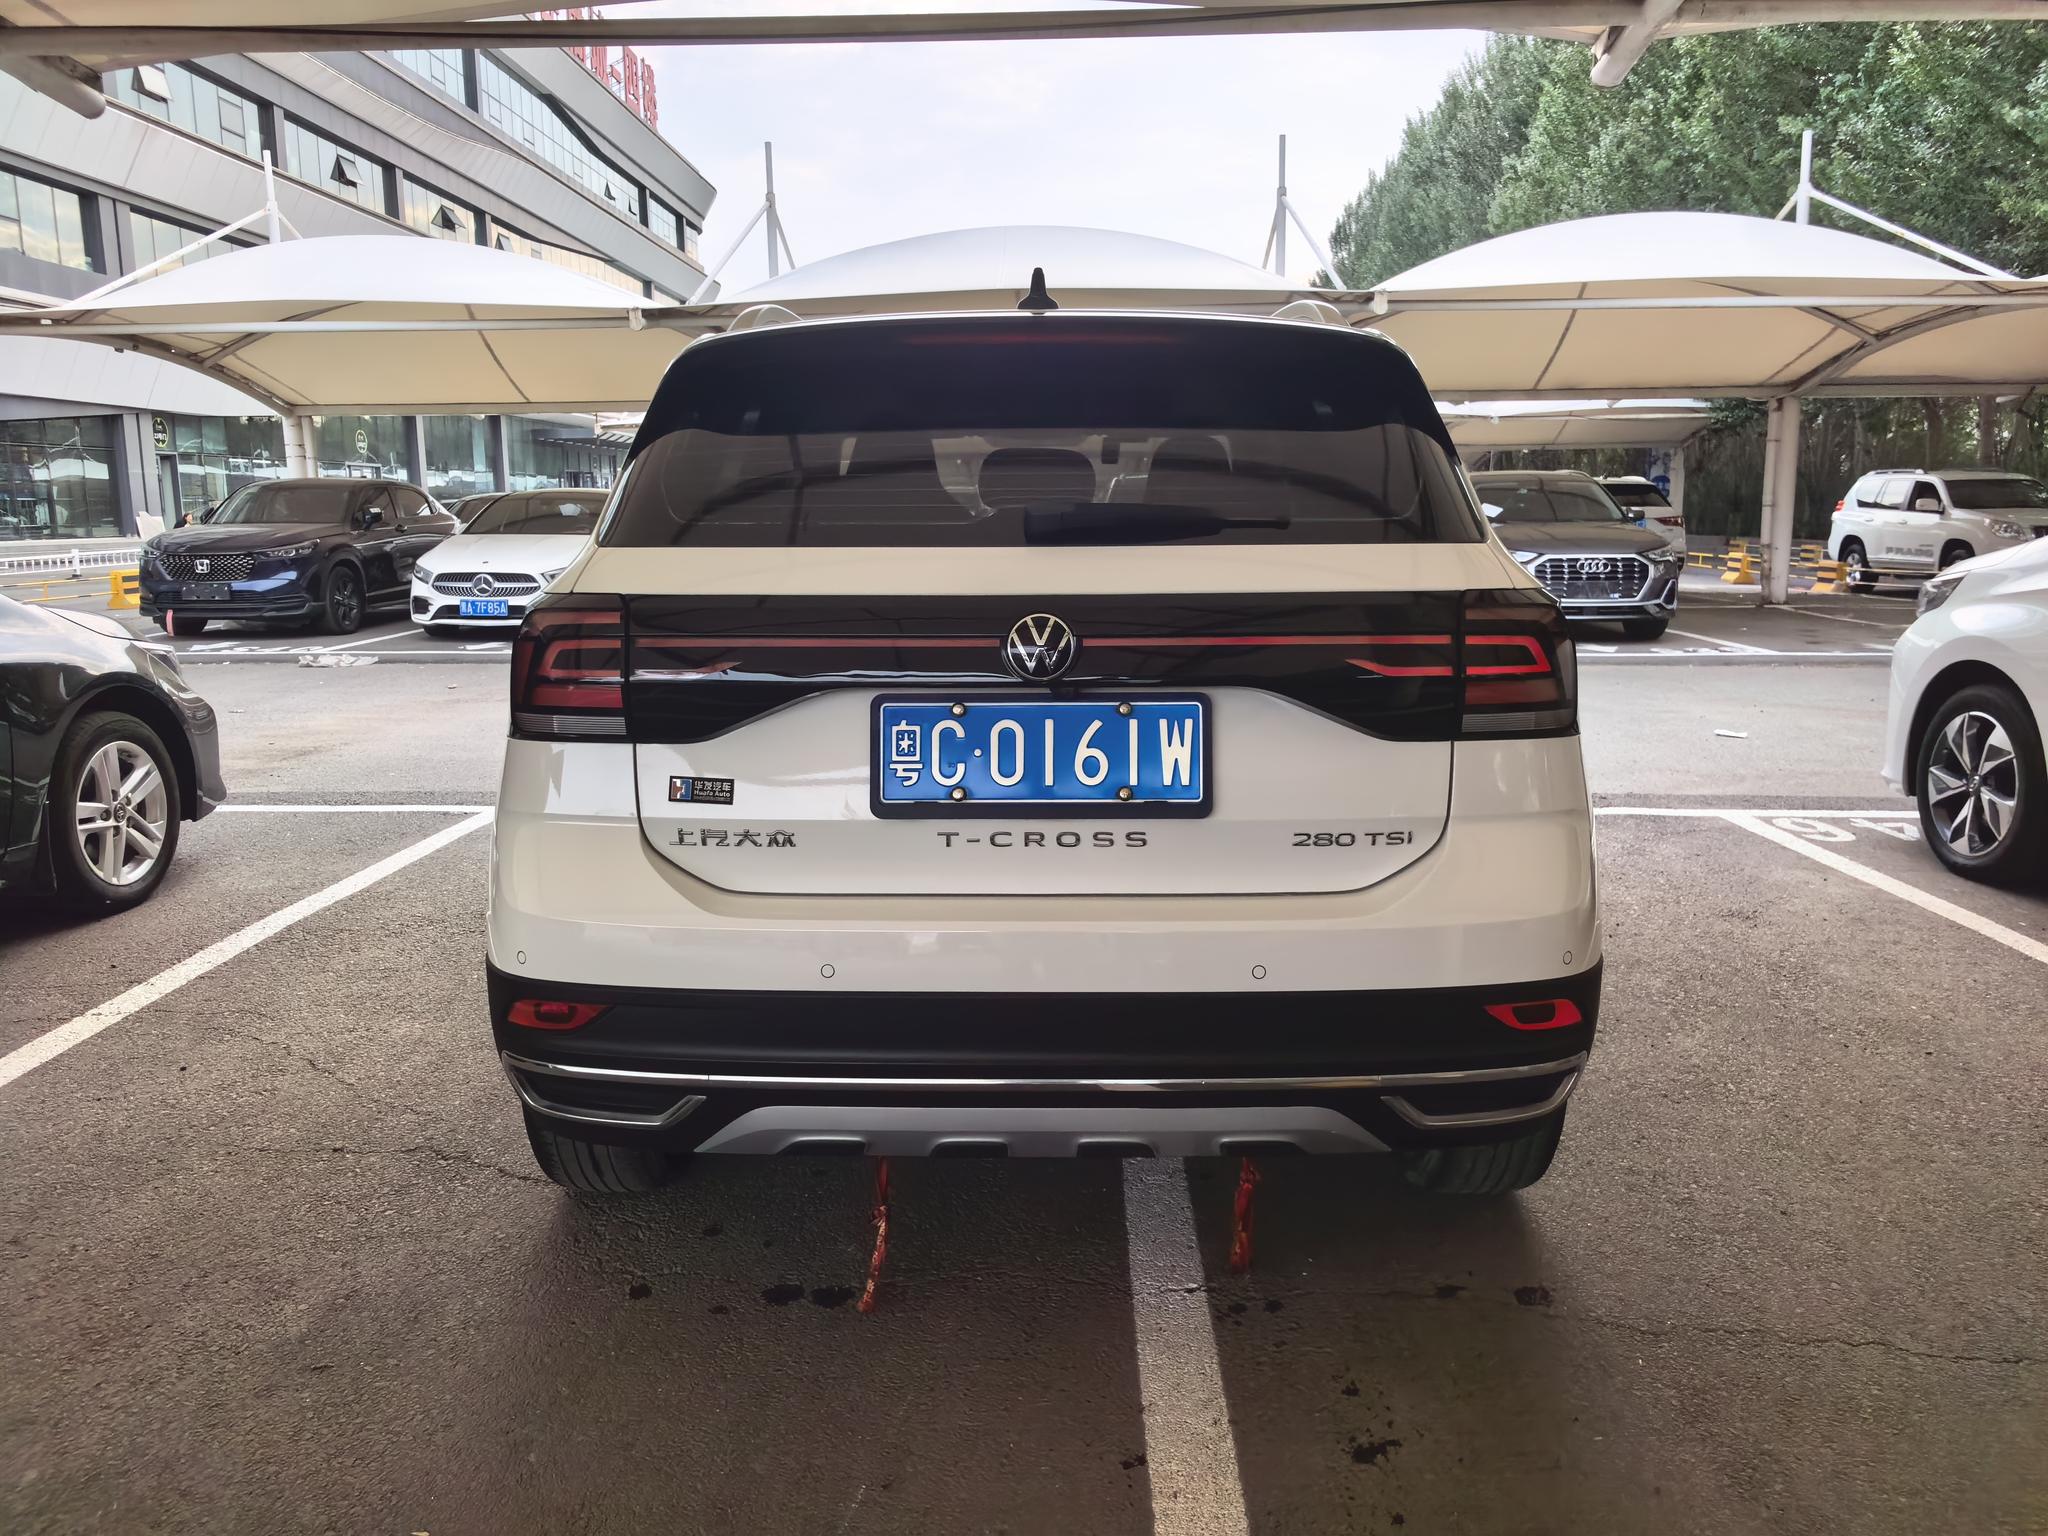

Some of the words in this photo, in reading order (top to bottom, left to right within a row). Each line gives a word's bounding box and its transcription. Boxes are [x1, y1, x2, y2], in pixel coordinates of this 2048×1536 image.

[889, 719, 1194, 787] 粤C·0161W
[669, 828, 797, 847] 上汽大众
[937, 831, 1148, 848] T-CROSS
[1292, 832, 1356, 847] 280
[1364, 830, 1413, 846] TSI
